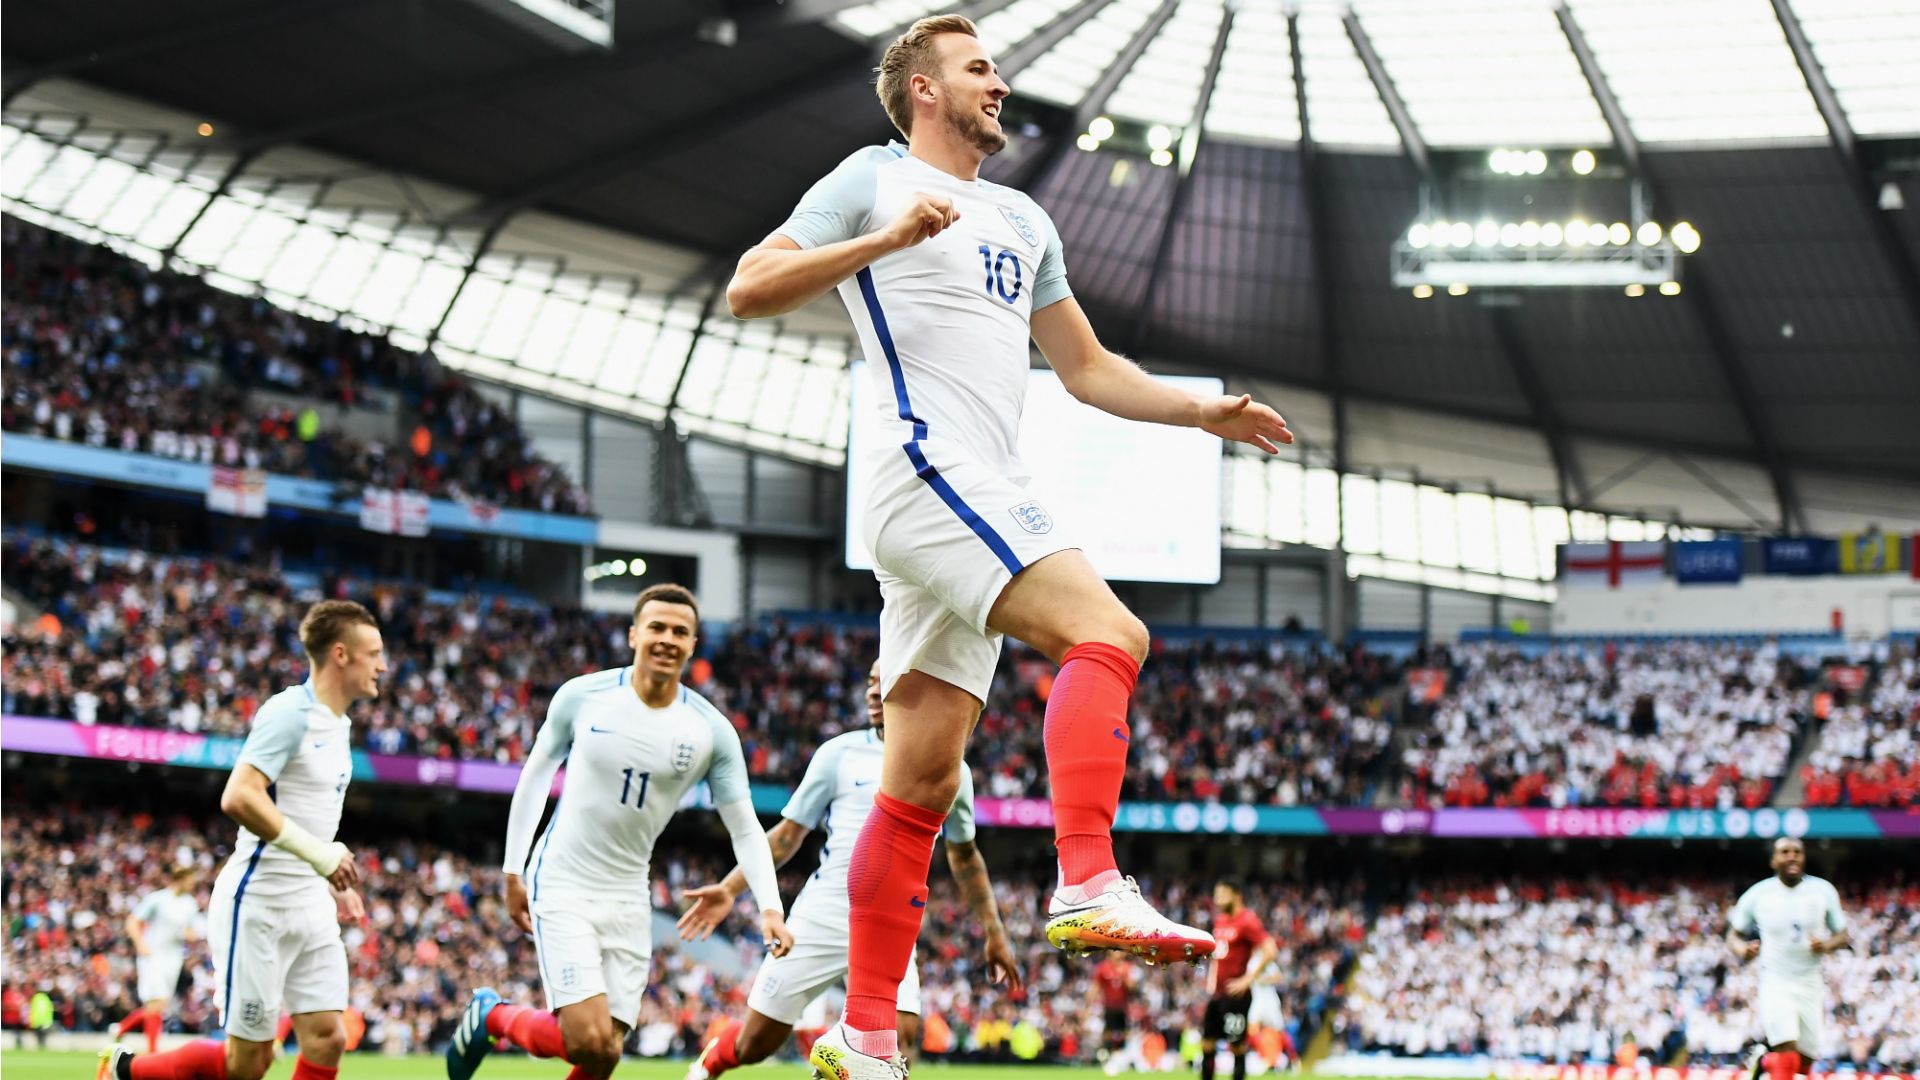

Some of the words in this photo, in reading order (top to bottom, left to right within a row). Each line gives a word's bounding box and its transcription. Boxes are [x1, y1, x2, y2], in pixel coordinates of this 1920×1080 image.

[978, 245, 1023, 304] 10
[96, 727, 206, 764] FOLLOW
[621, 767, 650, 809] 11
[1127, 803, 1166, 830] US
[1545, 809, 1669, 836] FOLLOW
[1676, 810, 1716, 836] US
